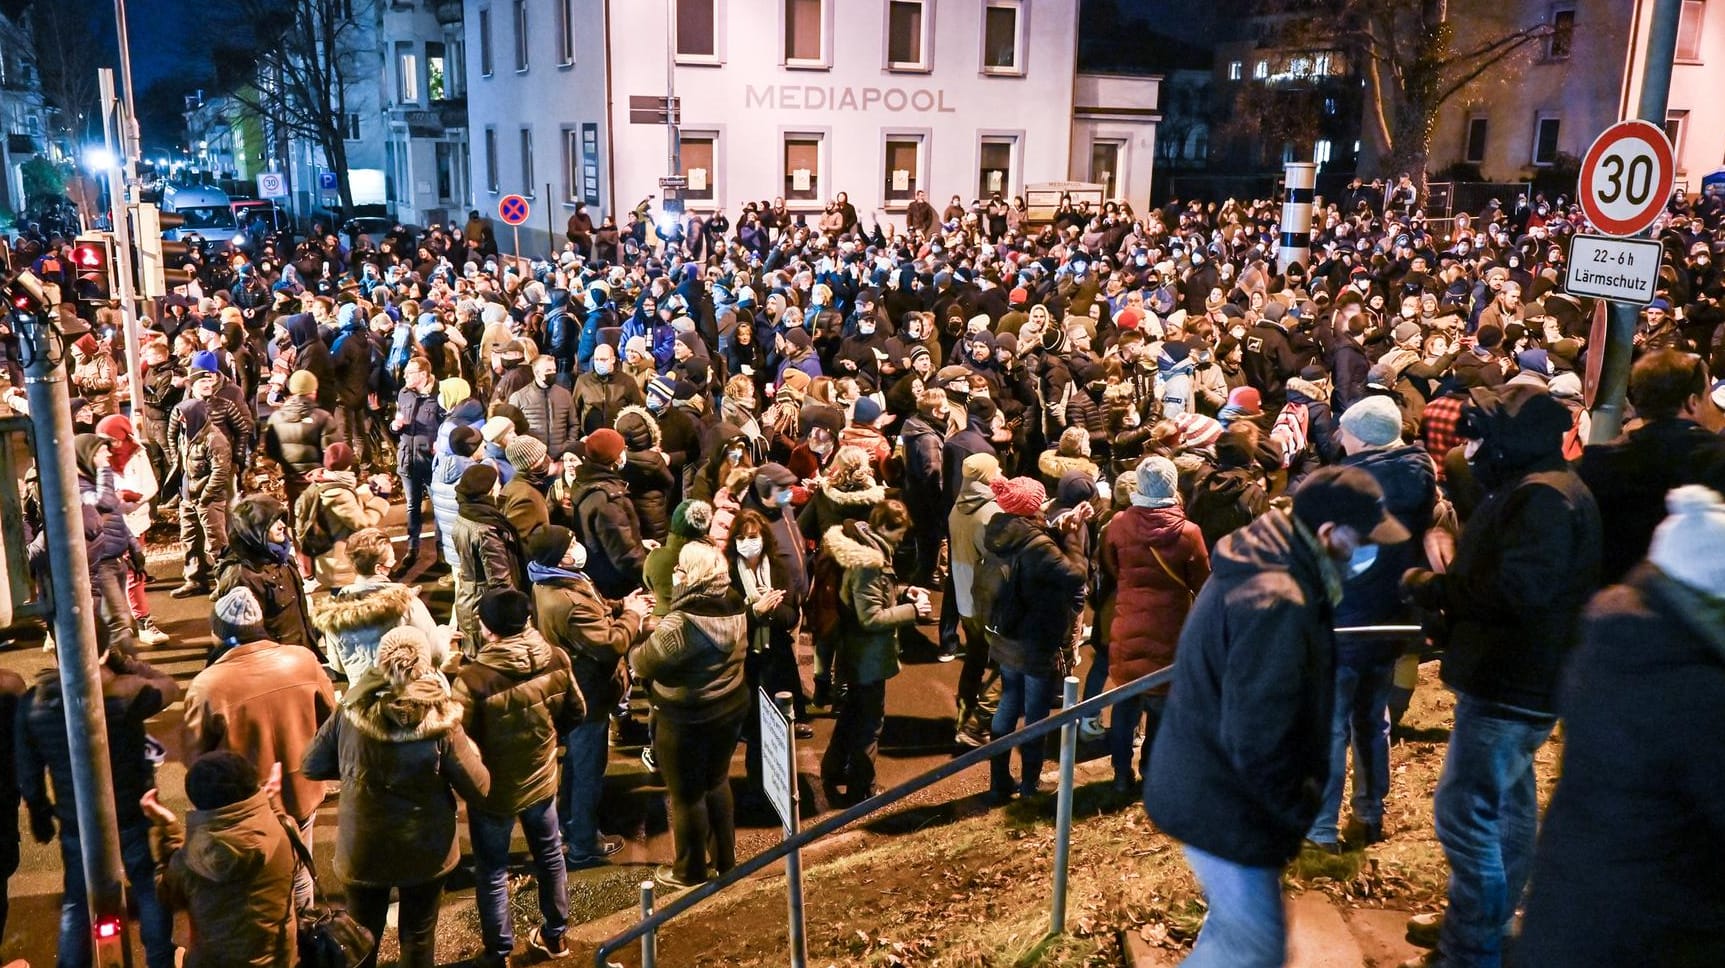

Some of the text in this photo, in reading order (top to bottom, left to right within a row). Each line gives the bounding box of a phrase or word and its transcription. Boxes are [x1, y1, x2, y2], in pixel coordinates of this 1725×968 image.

[745, 84, 956, 113] MEDIAPOOL
[266, 179, 276, 187] 30
[324, 175, 333, 187] P
[1598, 154, 1653, 205] 30
[1575, 268, 1647, 291] Lärmschutz
